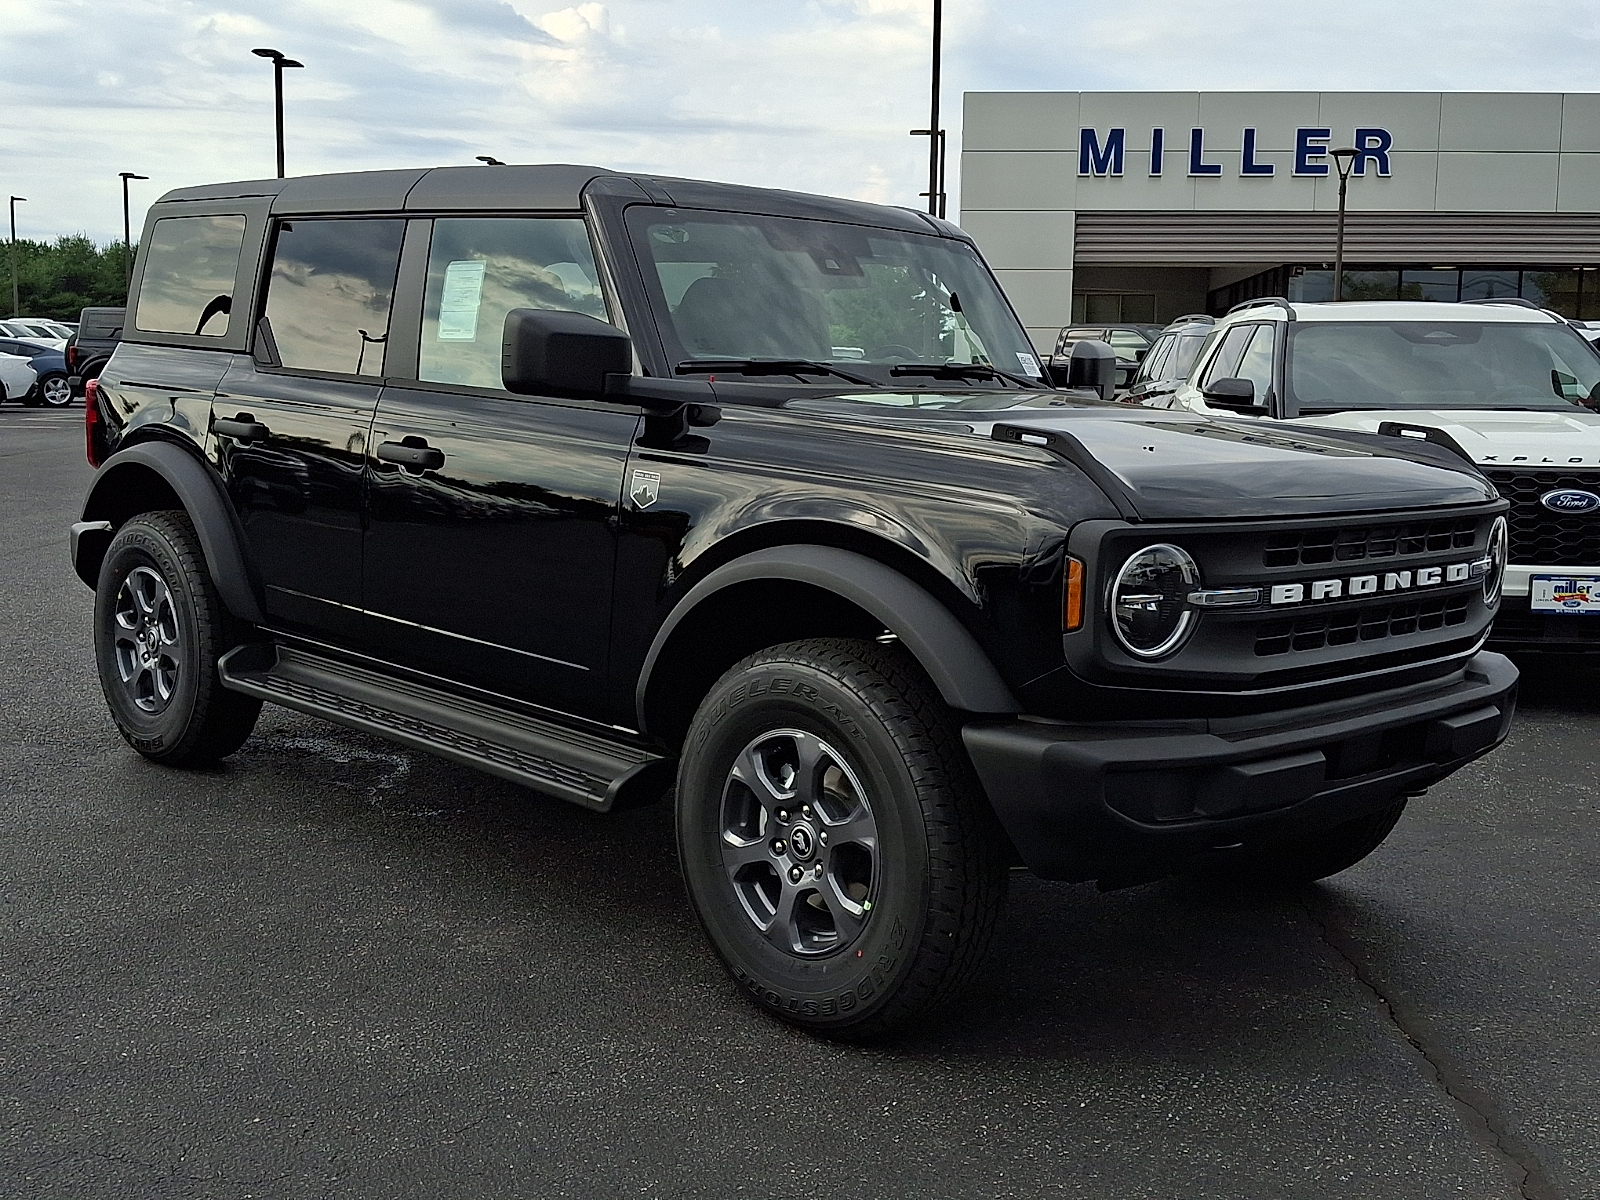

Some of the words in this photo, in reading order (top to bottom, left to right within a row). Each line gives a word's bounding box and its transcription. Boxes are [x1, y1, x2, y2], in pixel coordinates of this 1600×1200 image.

[1077, 126, 1393, 177] MILLER
[1482, 455, 1600, 464] XPLO
[1556, 494, 1589, 508] Ford
[1270, 563, 1469, 605] BRONCO
[1553, 581, 1593, 594] miller
[732, 914, 908, 1017] BRIDGESTONE
